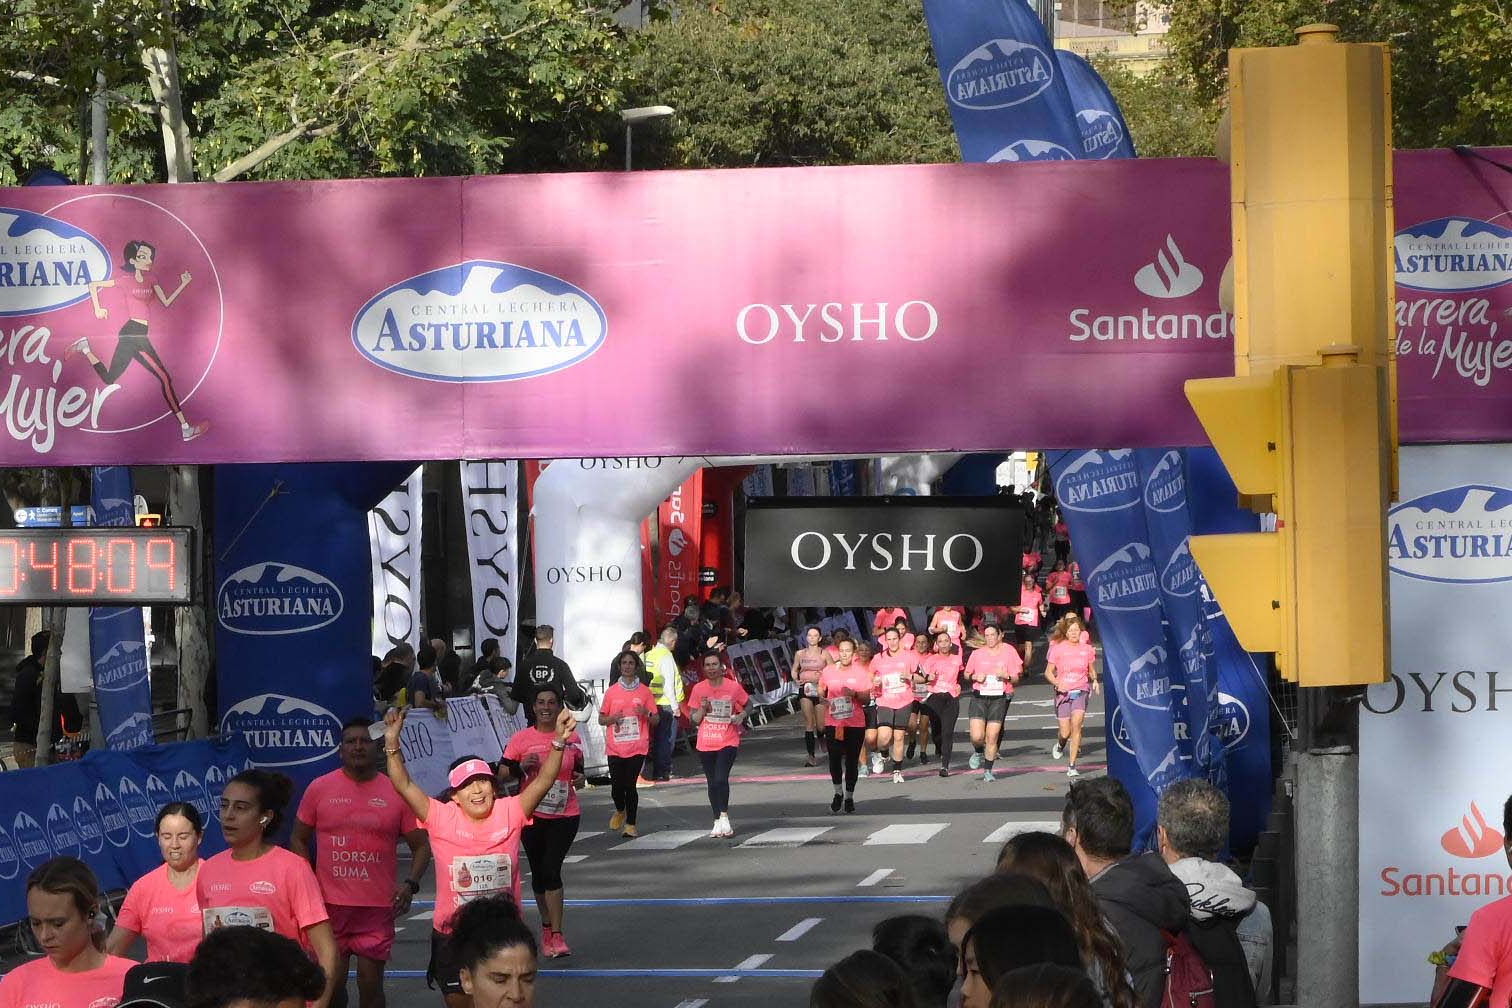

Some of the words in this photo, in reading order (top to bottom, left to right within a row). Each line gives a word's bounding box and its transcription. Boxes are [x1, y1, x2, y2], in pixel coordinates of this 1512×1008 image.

[14, 243, 87, 256] LECHERA
[1409, 242, 1461, 251] CENTRAL
[411, 303, 482, 317] CENTRAL
[498, 300, 579, 315] LECHERA
[373, 308, 587, 352] ASTURIANA
[735, 299, 939, 345] OYSHO
[1070, 309, 1235, 342] Santand
[1418, 329, 1435, 355] la
[1432, 322, 1512, 386] Muje
[1416, 519, 1483, 530] CENTRAL
[790, 531, 984, 573] OYSHO
[547, 564, 622, 584] OYSHO
[281, 586, 329, 594] LECHERA
[222, 592, 334, 619] ASTURIANA
[1361, 671, 1512, 714] OYSH
[243, 729, 334, 749] TURIANA
[332, 836, 345, 847] TU
[332, 851, 381, 863] DORSAL
[332, 867, 369, 879] SUMA
[1381, 867, 1512, 897] Santan
